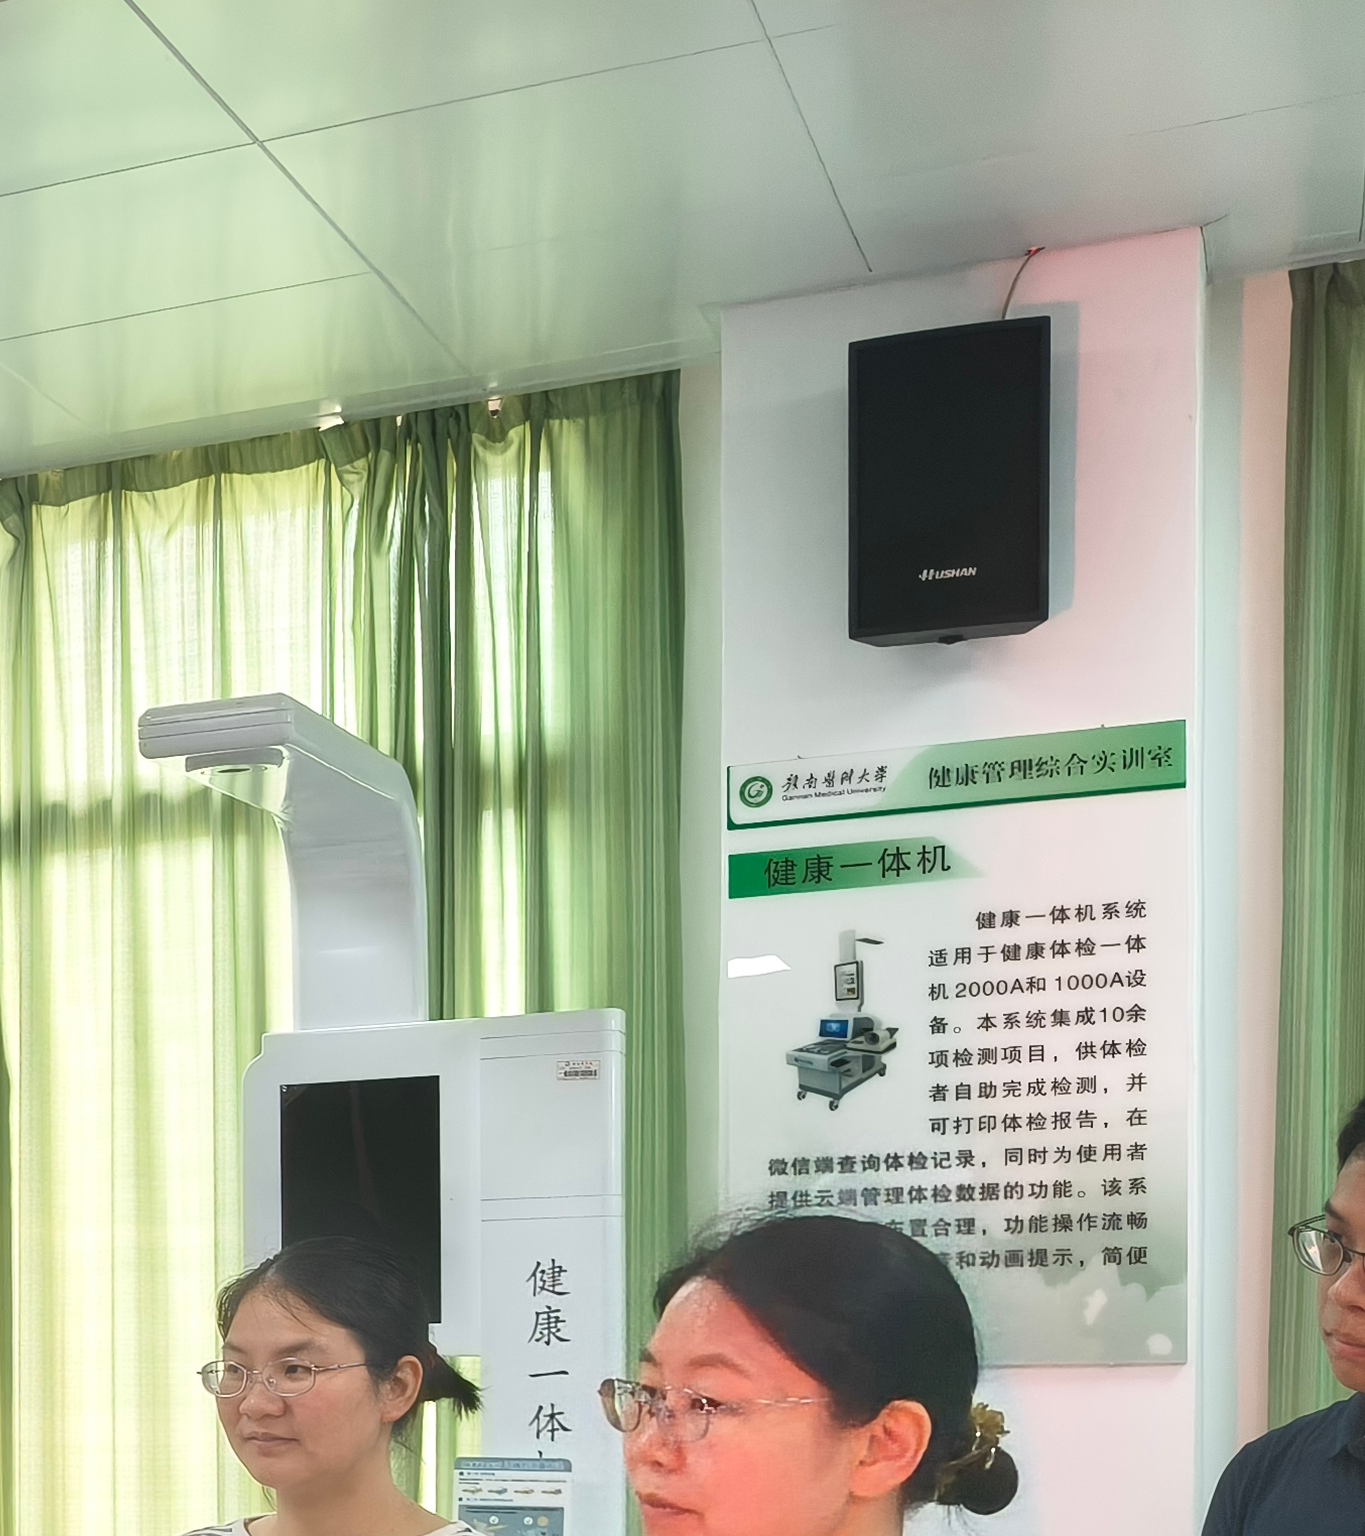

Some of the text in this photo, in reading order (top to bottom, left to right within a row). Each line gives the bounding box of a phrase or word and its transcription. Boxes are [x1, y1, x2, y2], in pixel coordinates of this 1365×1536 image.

[927, 744, 1174, 791] 健康管理综合实训室
[764, 844, 952, 889] 健康一体机
[975, 898, 1147, 930] 健康一体机系统
[928, 933, 1147, 967] 适用于健康体检一体
[526, 1258, 572, 1458] 健康一体
